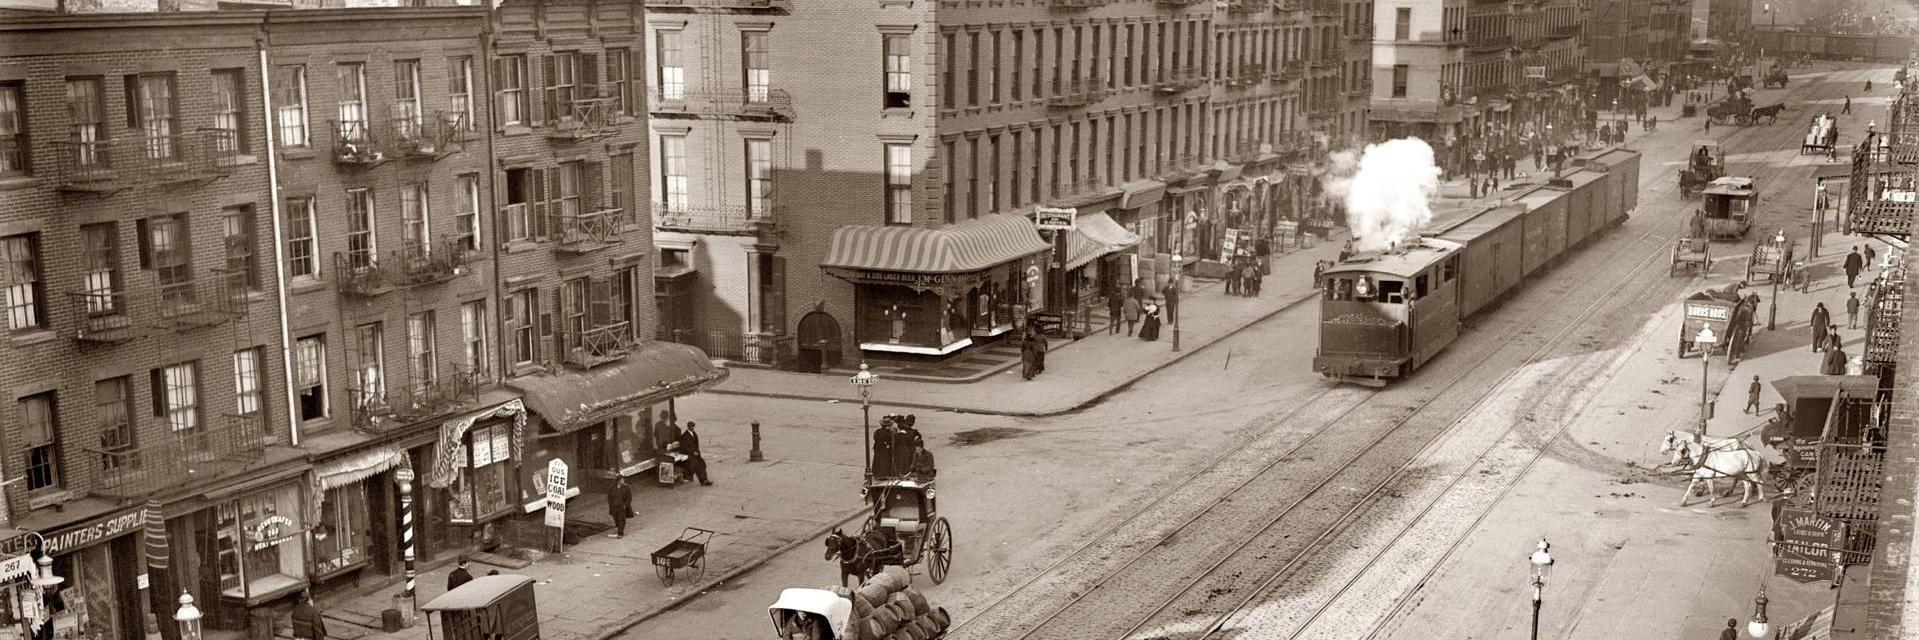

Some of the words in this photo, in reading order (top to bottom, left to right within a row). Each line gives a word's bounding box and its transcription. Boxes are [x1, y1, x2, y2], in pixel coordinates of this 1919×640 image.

[549, 474, 566, 486] ICE
[547, 484, 566, 496] COAL
[547, 501, 565, 512] WOOD
[43, 523, 103, 554] PAINTERS
[106, 509, 148, 536] SUPPLIE
[1785, 539, 1828, 557] TAILOR
[4, 560, 21, 574] 267
[656, 556, 671, 567] ICE
[1791, 567, 1817, 578] 272
